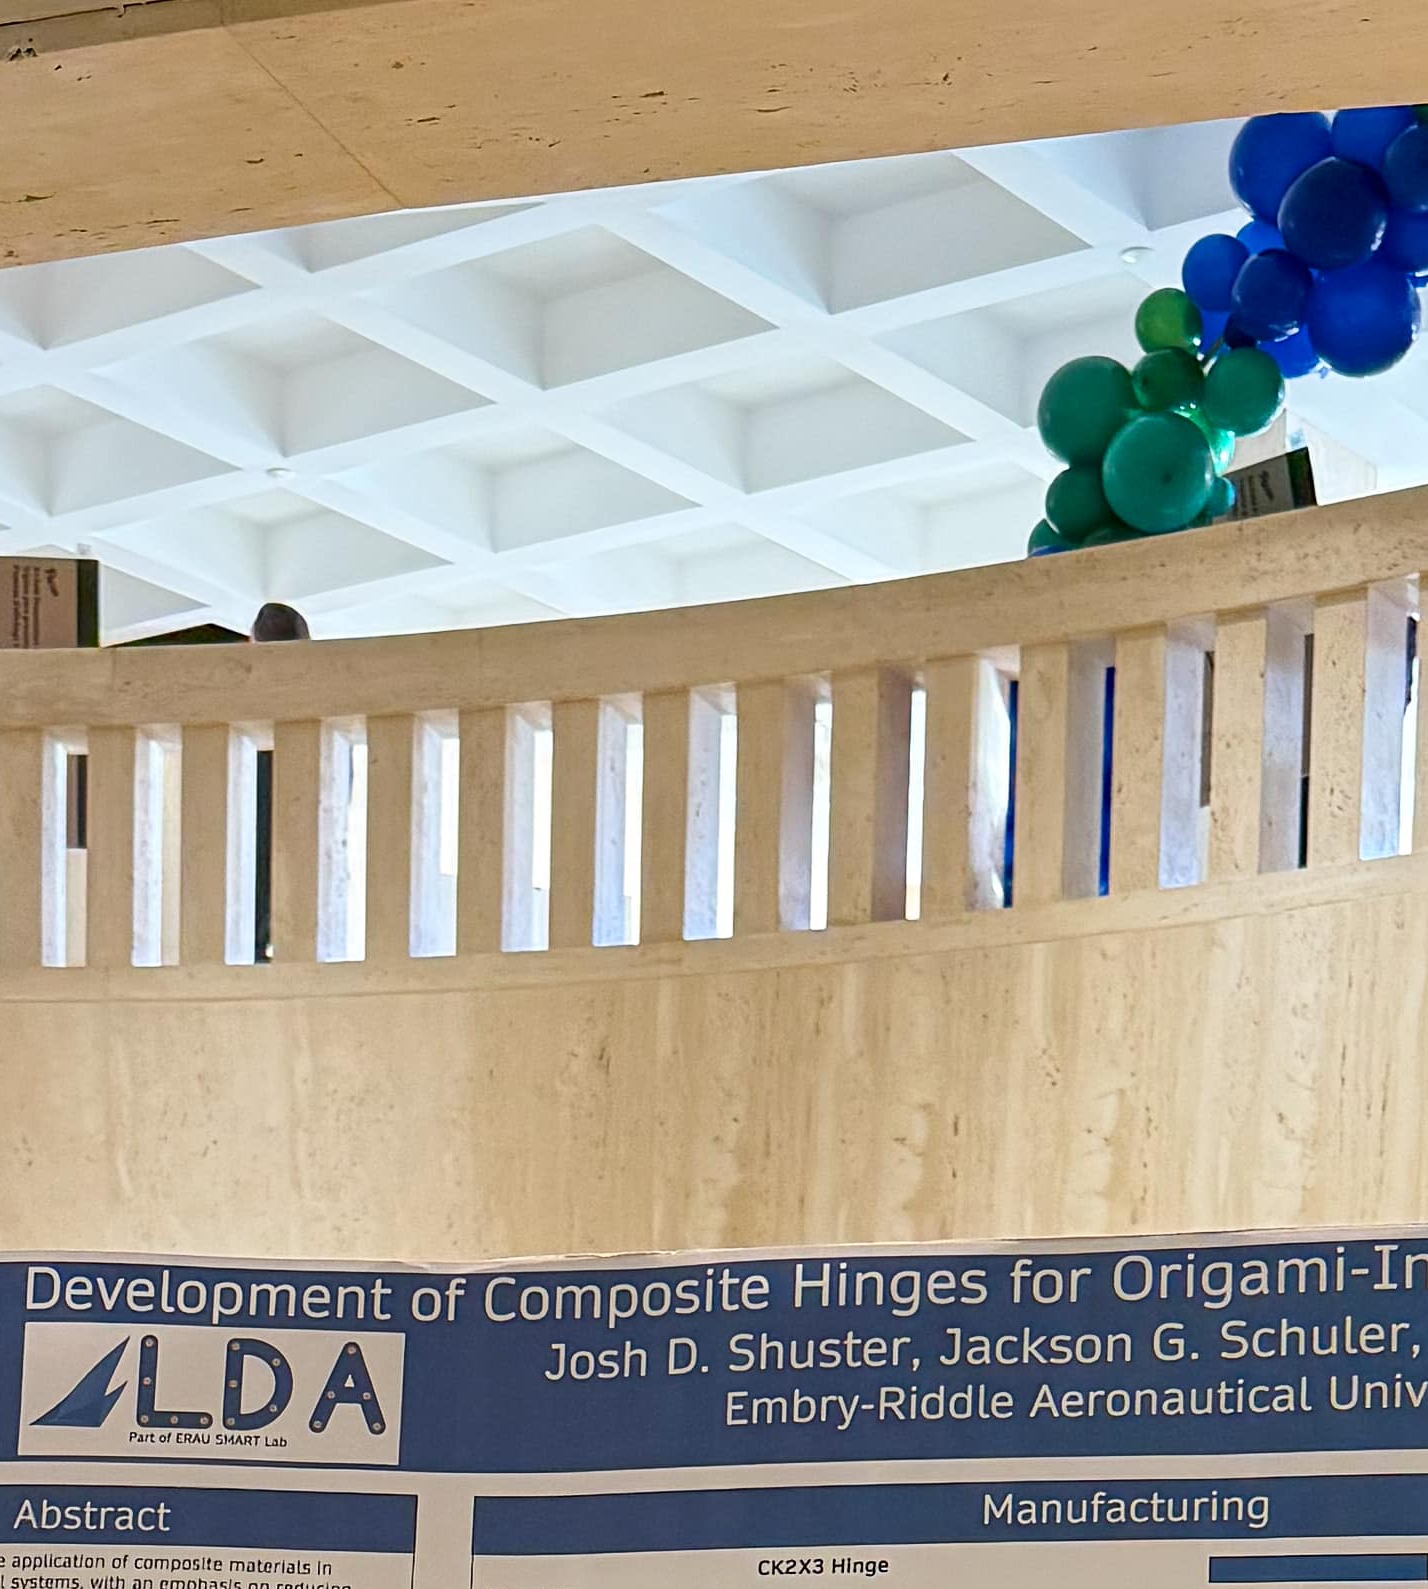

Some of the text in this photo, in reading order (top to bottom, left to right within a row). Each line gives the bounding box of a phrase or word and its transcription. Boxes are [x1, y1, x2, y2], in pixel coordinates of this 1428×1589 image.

[26, 1265, 392, 1325] Development
[411, 1277, 467, 1322] of
[485, 1268, 770, 1329] Composite
[794, 1262, 988, 1317] Hinges
[1009, 1258, 1092, 1304] for
[544, 1340, 647, 1381] Josh
[668, 1337, 709, 1375] D.
[728, 1330, 920, 1372] Shuster,
[939, 1326, 1132, 1365] Jackson
[1153, 1322, 1199, 1361] G.
[1220, 1315, 1420, 1359] Schuler,
[726, 1384, 1014, 1430] Embry-Riddle
[1029, 1375, 1313, 1418] Aeronautical
[128, 1431, 288, 1448] Part of ERAU SMART Lab
[13, 1499, 172, 1532] Abstract
[983, 1490, 1269, 1529] Manufacturing
[11, 1553, 105, 1571] application
[111, 1554, 129, 1569] of
[134, 1556, 223, 1573] composite
[229, 1559, 311, 1575] materials
[317, 1560, 332, 1576] in
[758, 1557, 889, 1578] CK2X3 Hinge
